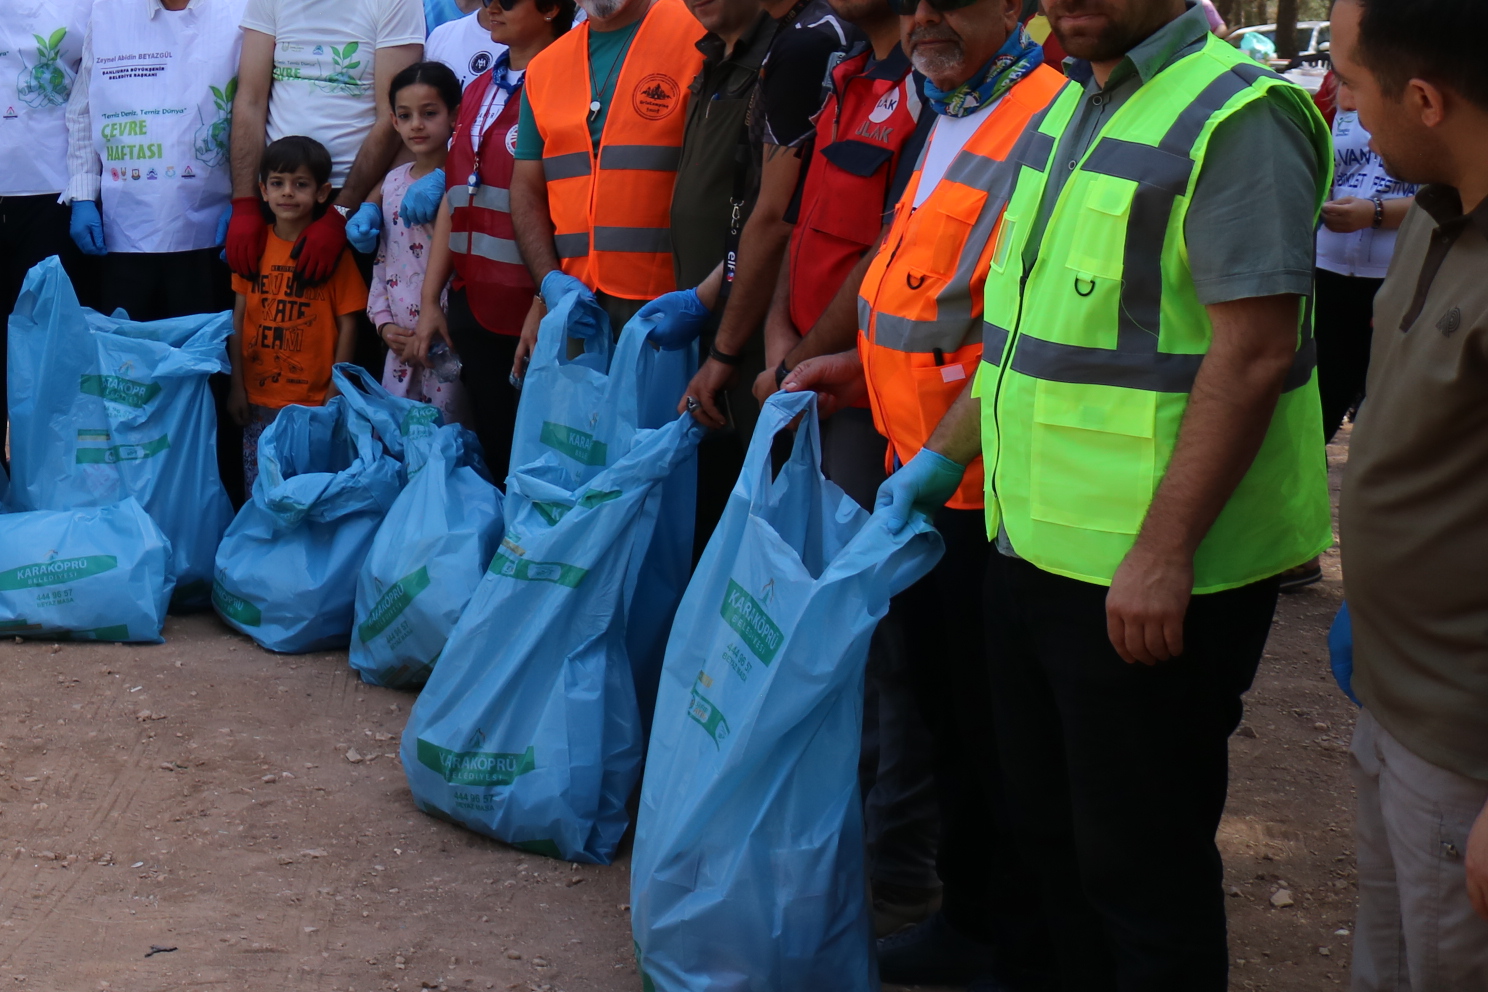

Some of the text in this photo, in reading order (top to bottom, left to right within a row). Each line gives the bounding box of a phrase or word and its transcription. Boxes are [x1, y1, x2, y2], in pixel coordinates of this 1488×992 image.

[101, 120, 147, 142] ÇEVRE
[106, 143, 163, 161] HAFTASI
[261, 298, 311, 323] SKATE
[17, 558, 87, 580] KARAKÖPRÜ
[36, 593, 50, 601] 444
[63, 589, 73, 597] 57
[728, 589, 780, 650] KARAKÖPRÜ
[439, 751, 516, 772] KARAKÖPRÜ
